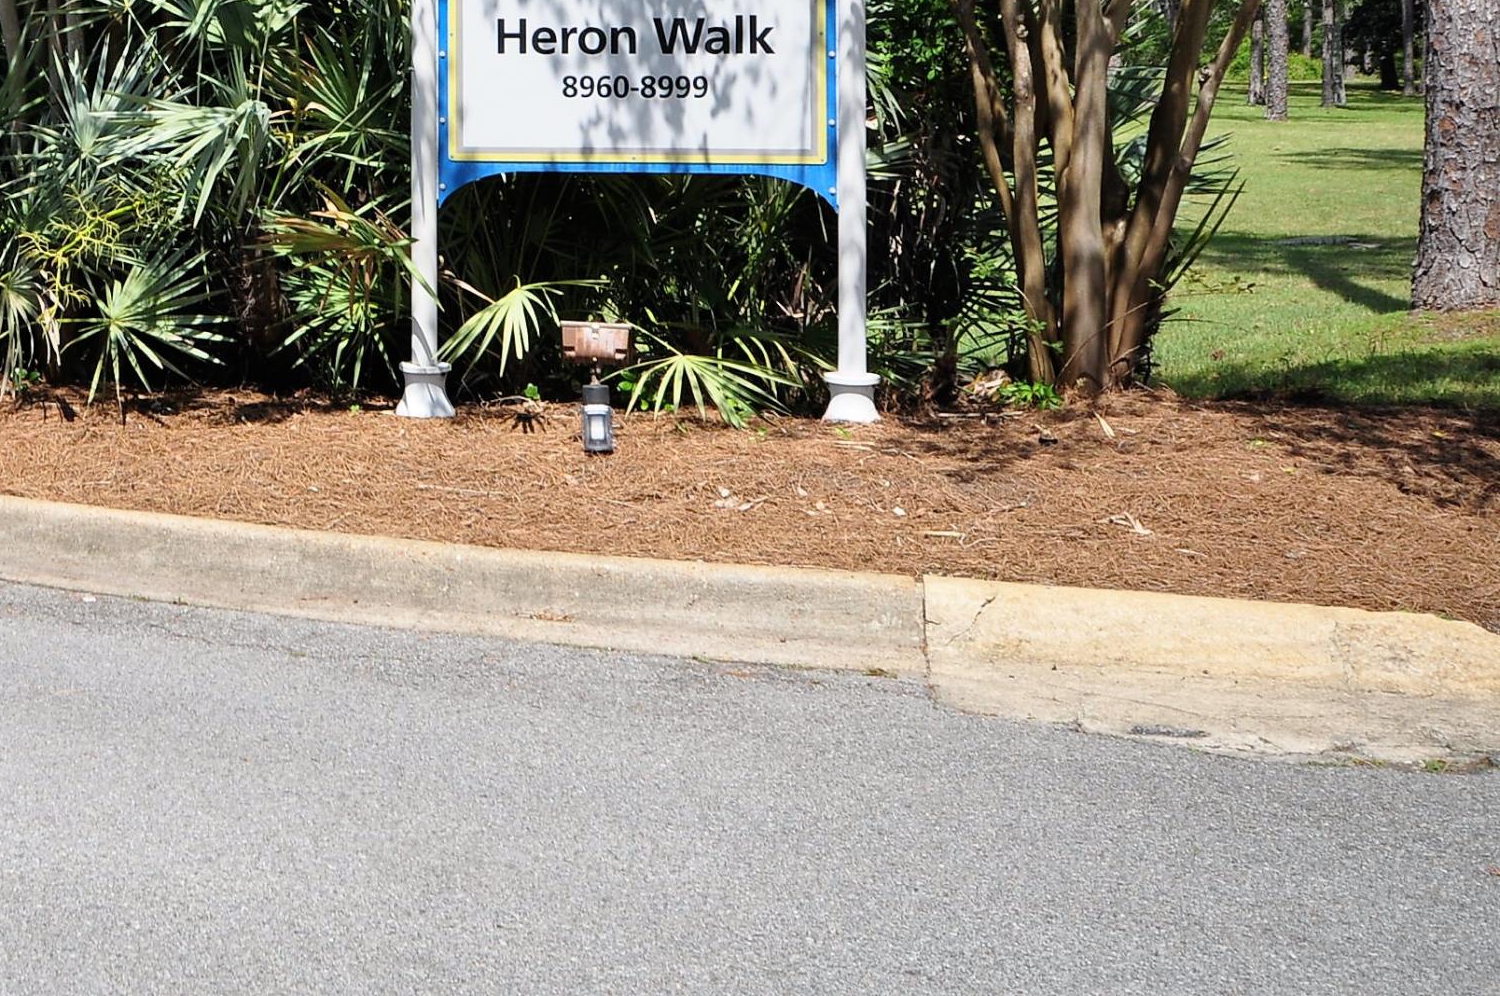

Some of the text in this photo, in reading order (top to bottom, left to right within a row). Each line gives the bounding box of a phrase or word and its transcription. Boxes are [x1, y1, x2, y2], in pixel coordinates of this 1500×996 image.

[497, 15, 775, 55] Heron Walk
[562, 76, 708, 99] 8960-8999
